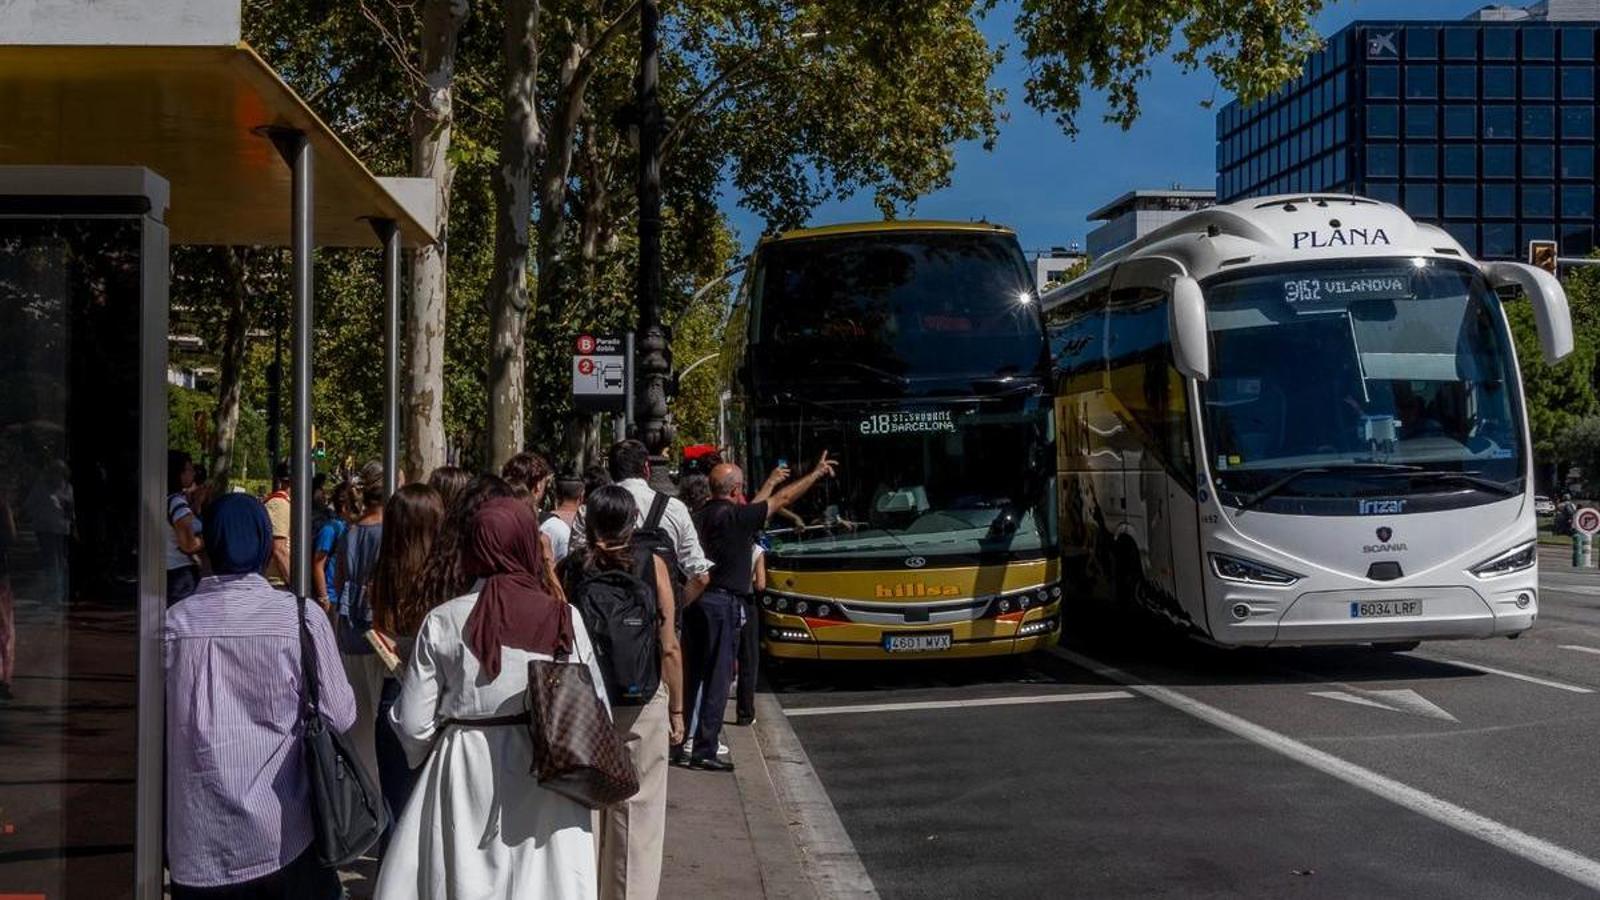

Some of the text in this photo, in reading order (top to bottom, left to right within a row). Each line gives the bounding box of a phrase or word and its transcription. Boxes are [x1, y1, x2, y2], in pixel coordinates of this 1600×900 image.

[1325, 279, 1403, 293] VILANOVA
[860, 414, 890, 434] e18
[891, 421, 954, 433] BARCELONA
[1363, 543, 1408, 553] SCANIA
[875, 583, 960, 598] hillsa
[1360, 603, 1391, 616] 6034
[890, 635, 949, 649] 4601 MVX
